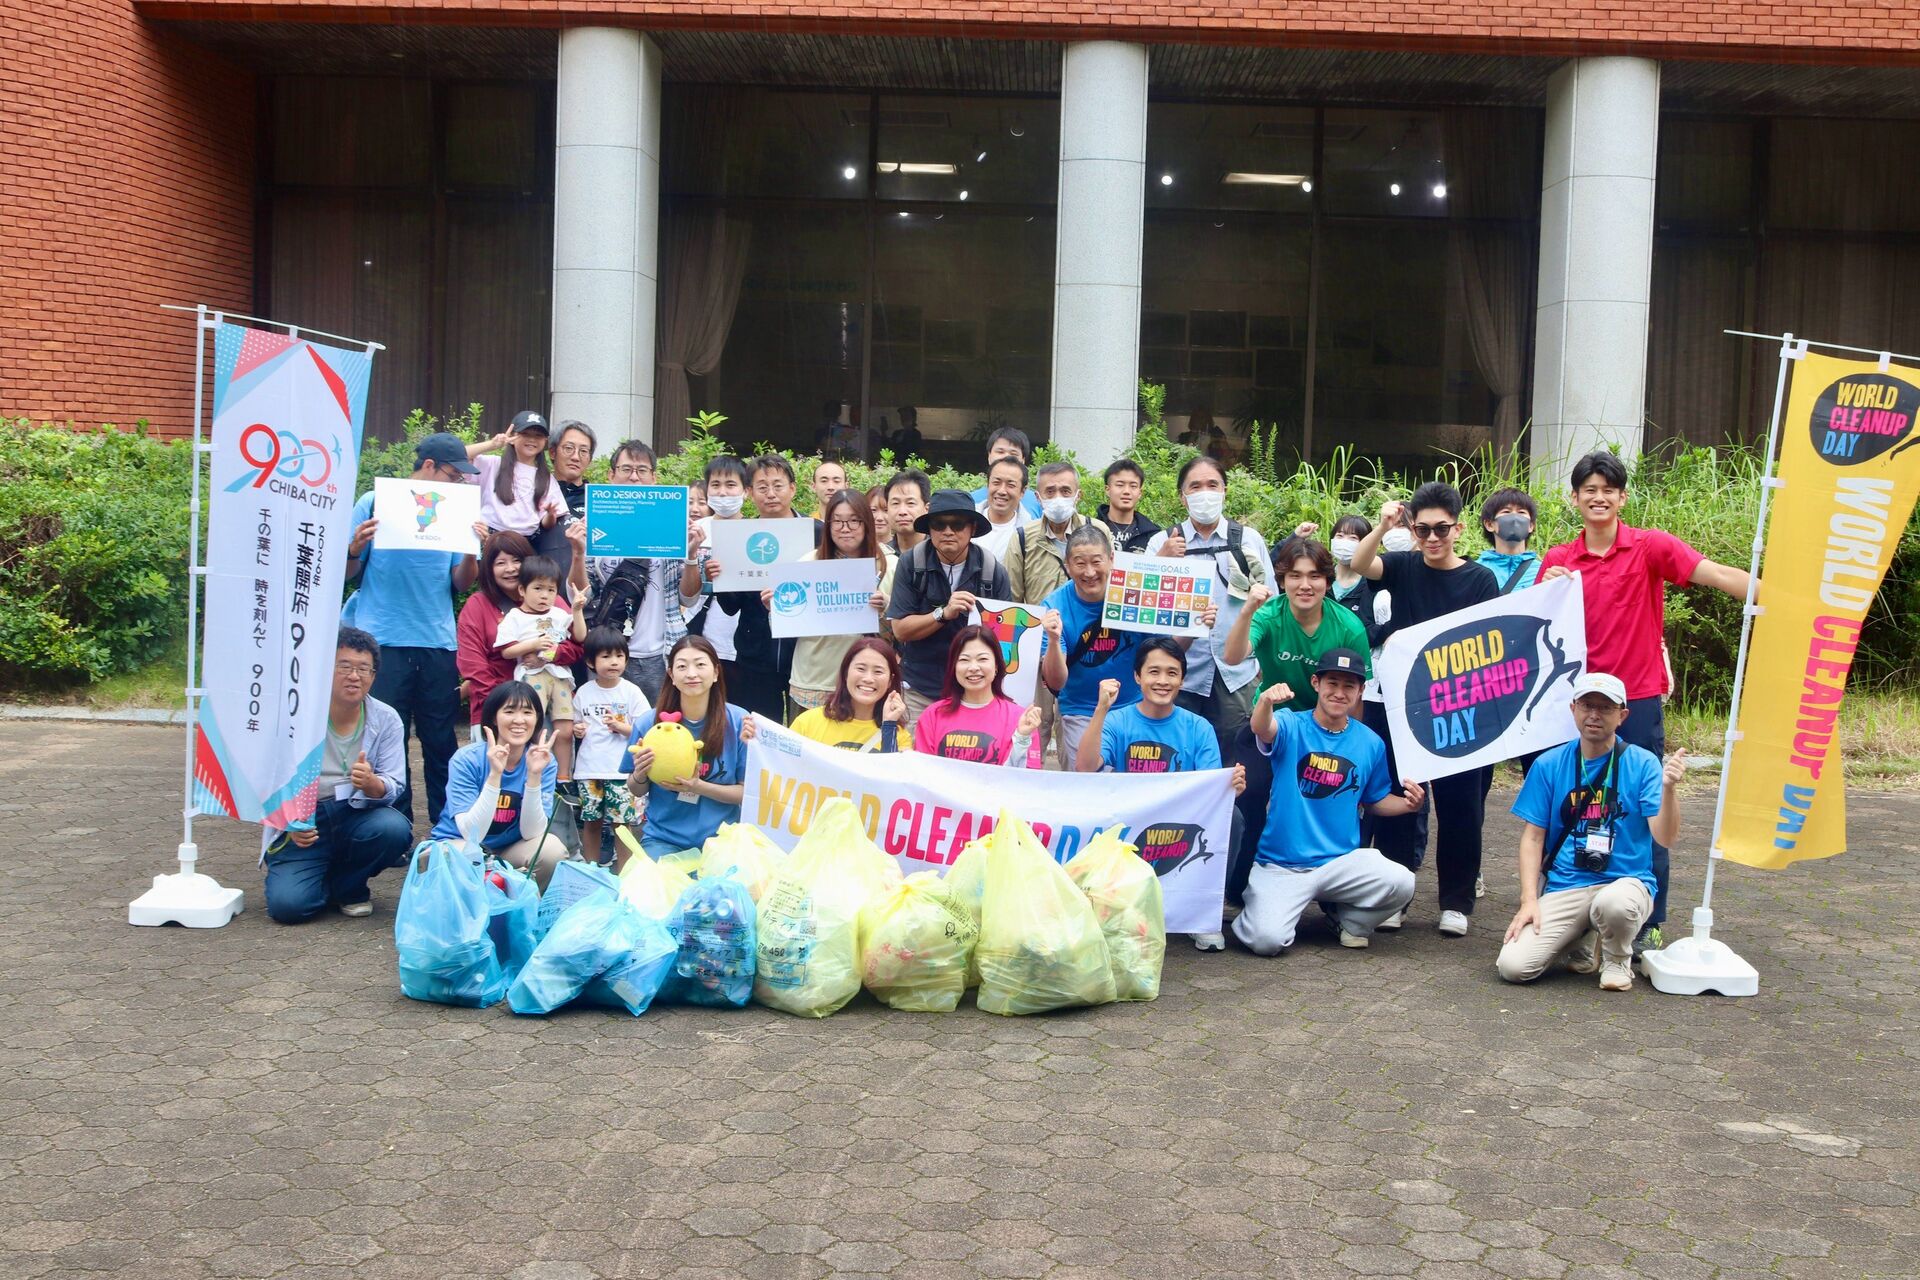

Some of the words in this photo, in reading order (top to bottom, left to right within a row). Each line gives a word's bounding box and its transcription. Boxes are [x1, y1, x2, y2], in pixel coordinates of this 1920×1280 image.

[1836, 381, 1899, 410] WORLD
[1829, 406, 1908, 437] CLEANUP
[1822, 430, 1861, 457] DAY
[269, 479, 307, 502] CHIBA
[309, 493, 337, 511] CITY
[592, 490, 611, 499] PRO
[613, 490, 646, 500] DESIGN
[647, 491, 682, 500] STUDIO
[255, 508, 272, 566] 千の葉に
[1819, 476, 1895, 611] WORLD
[1160, 565, 1190, 574] GOALS
[815, 581, 839, 593] CGM
[1424, 629, 1504, 681] WORLD
[1429, 657, 1529, 716] CLEANUP
[246, 664, 264, 733] 900年
[1432, 707, 1477, 750] DAY
[946, 734, 979, 748] WORLD
[1130, 745, 1161, 760] WORLD
[1128, 759, 1168, 773] CLEANUP
[1309, 753, 1339, 771] WORLD
[1304, 767, 1344, 787] CLEANUP
[1146, 829, 1185, 846] WORLD
[1142, 842, 1189, 861] CLEANUP
